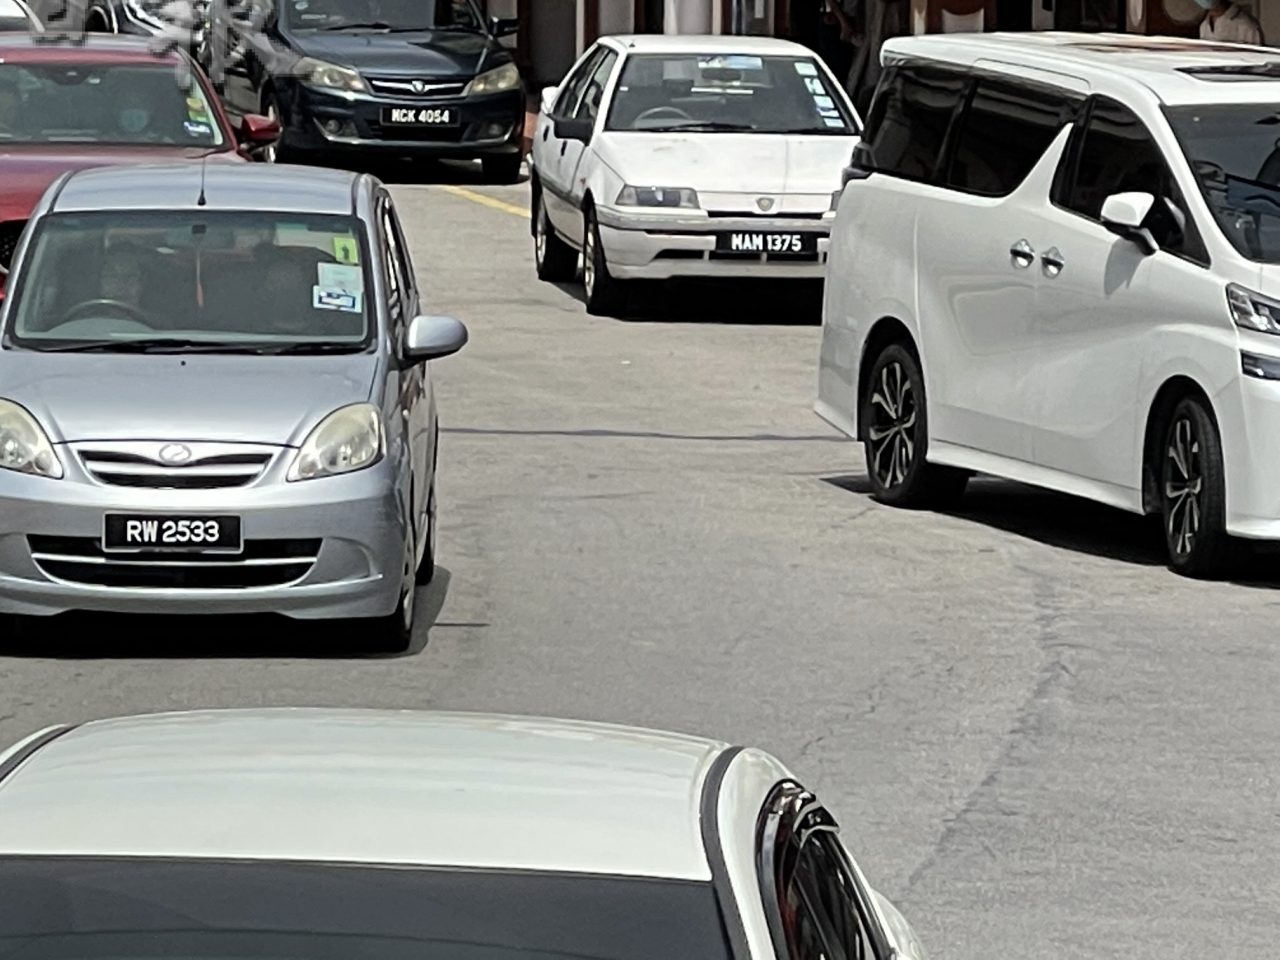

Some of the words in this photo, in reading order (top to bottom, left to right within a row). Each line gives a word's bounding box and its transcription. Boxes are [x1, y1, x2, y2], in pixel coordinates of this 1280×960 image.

[418, 109, 450, 123] 4054
[766, 234, 802, 252] 1375
[127, 520, 158, 542] RW
[162, 520, 220, 543] 2533
